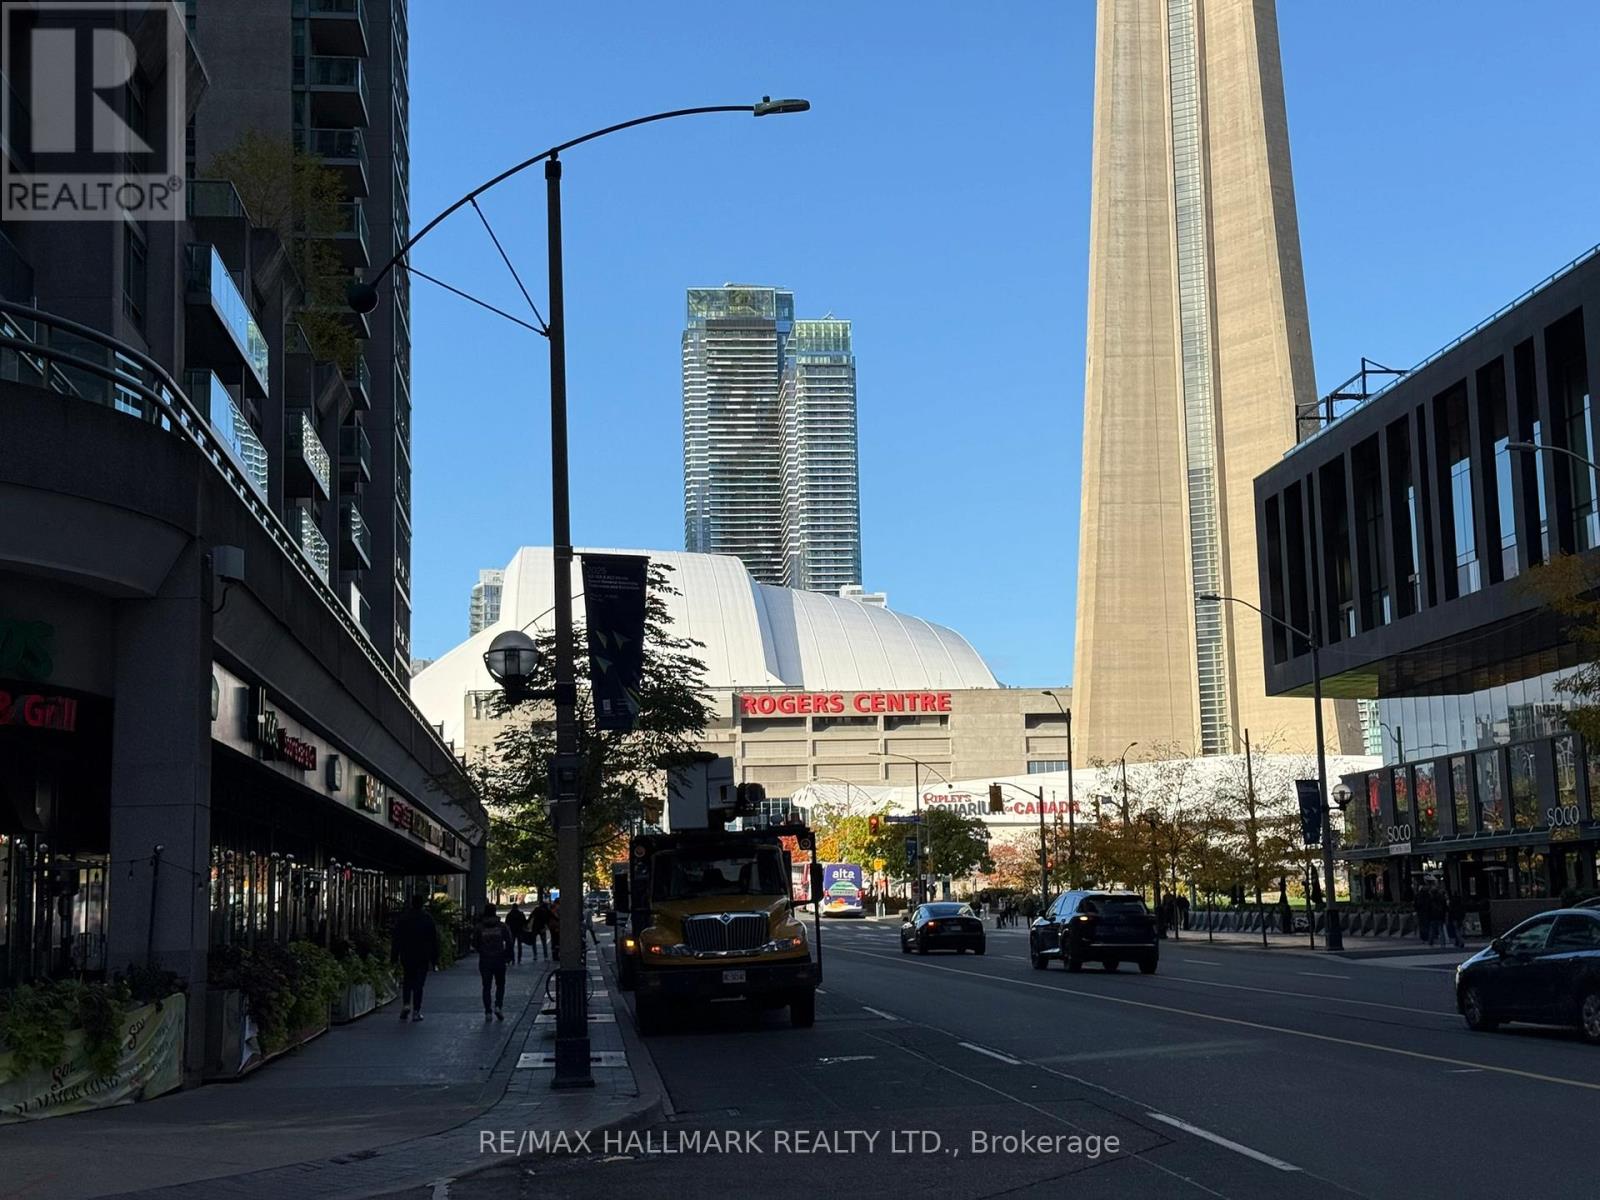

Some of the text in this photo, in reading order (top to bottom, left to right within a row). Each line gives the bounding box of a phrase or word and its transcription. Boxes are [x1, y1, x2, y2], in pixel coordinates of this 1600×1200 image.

[23, 693, 78, 733] Grill
[741, 692, 952, 714] ROGERS CENTRE
[923, 792, 972, 805] RIPLEY'S
[1546, 805, 1580, 828] SOCO
[1387, 823, 1411, 843] SOCO
[832, 868, 855, 879] alta
